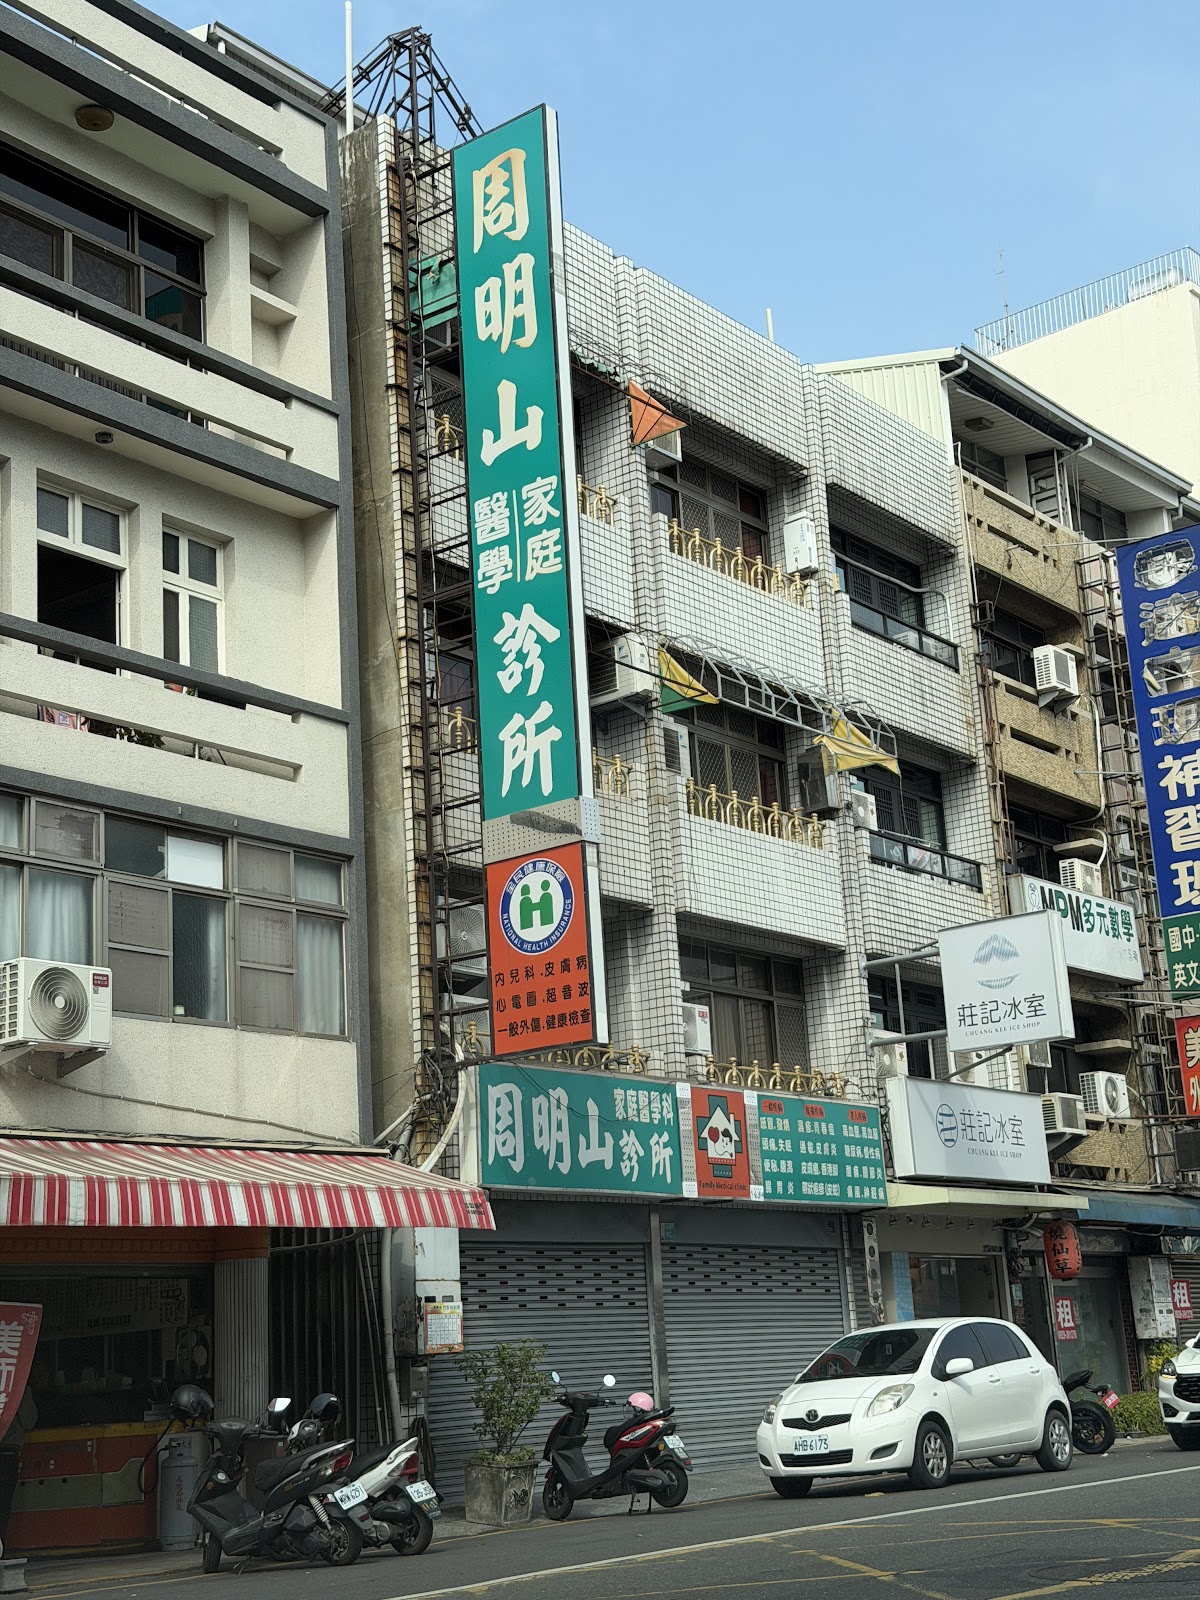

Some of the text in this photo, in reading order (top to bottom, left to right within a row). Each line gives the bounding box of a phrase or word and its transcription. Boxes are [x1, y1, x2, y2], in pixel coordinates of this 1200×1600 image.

[474, 491, 513, 594] 醫學
[521, 476, 563, 581] 家庭
[502, 898, 572, 951] NATIONAL HEALTH INSURANCE
[957, 993, 1047, 1029] 莊記冰室
[965, 1028, 993, 1037] CHUANG
[995, 1026, 1008, 1034] KEE
[1022, 1021, 1041, 1030] SHOP
[613, 1086, 674, 1126] 家庭醫學科
[959, 1109, 1026, 1147] 莊記冰室
[967, 1147, 989, 1156] CHUANG
[1009, 1151, 1022, 1159] SHOP
[1048, 1227, 1072, 1273] 燒仙草
[1056, 1298, 1075, 1328] 租
[1172, 1281, 1191, 1309] 租
